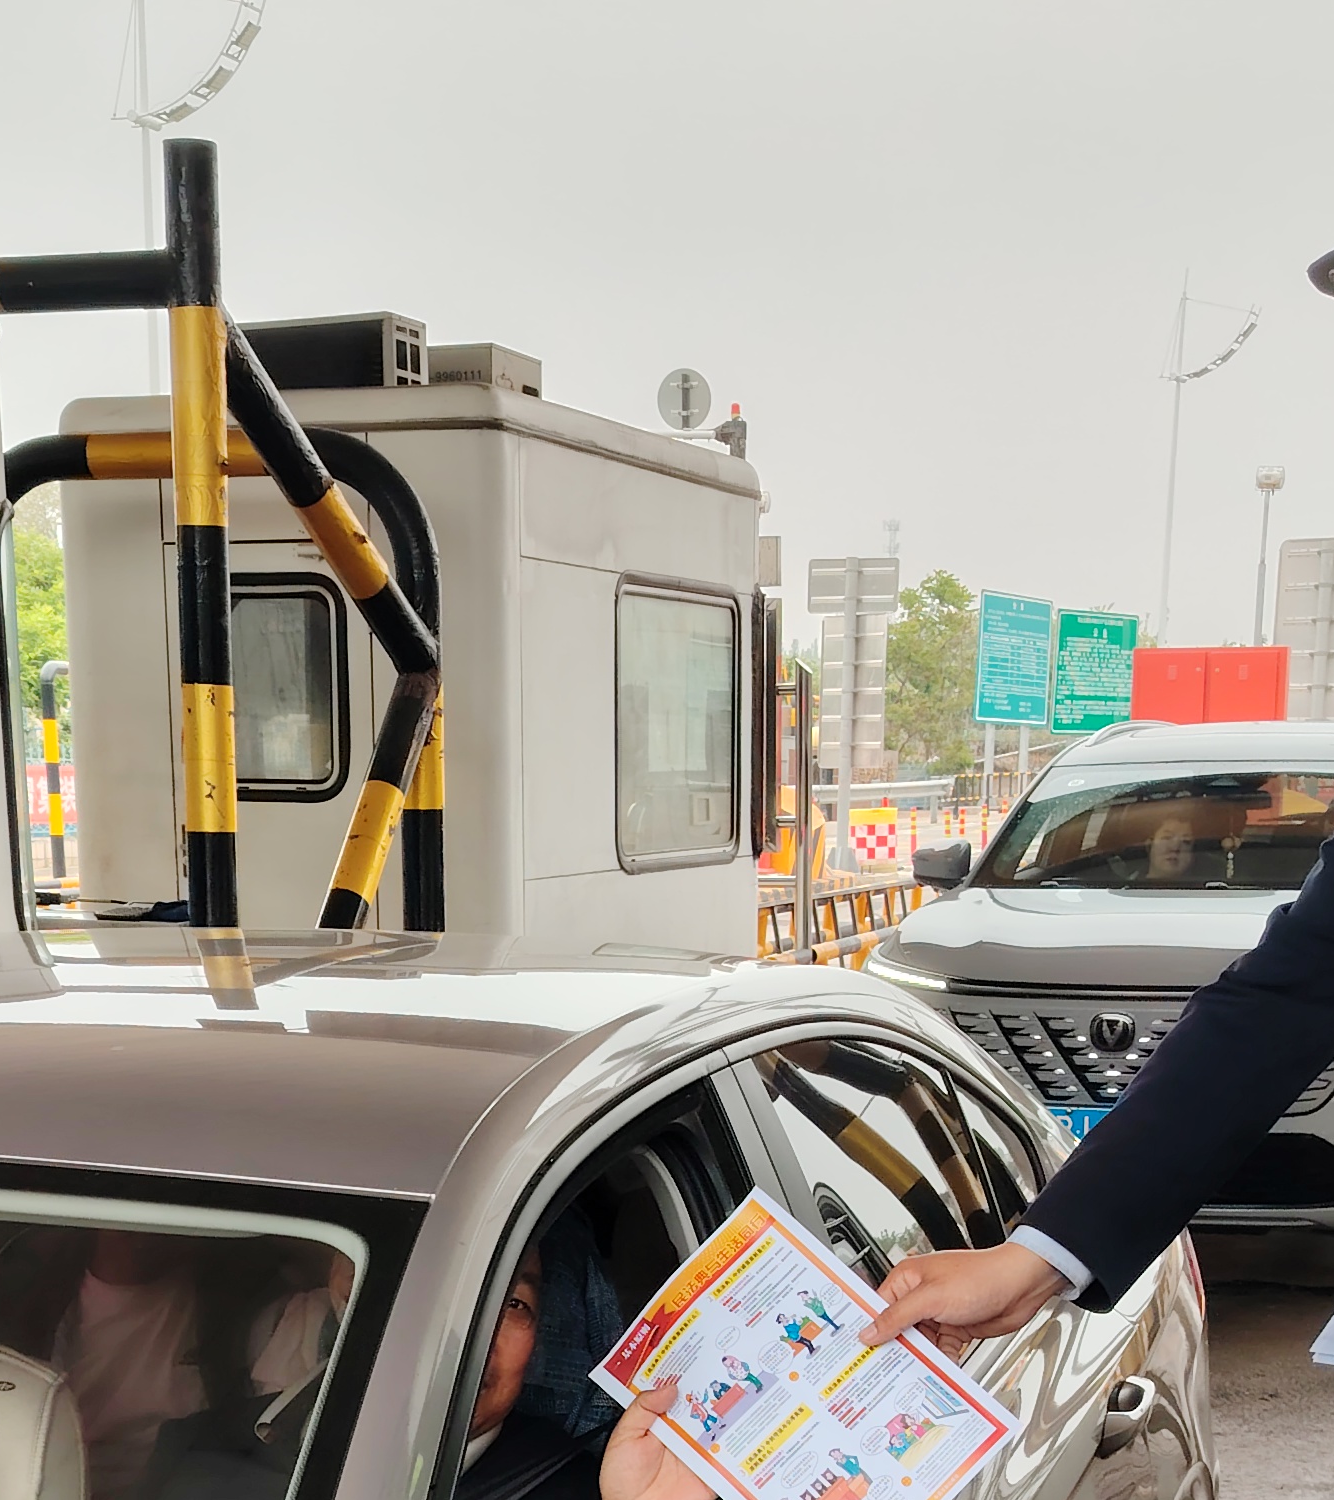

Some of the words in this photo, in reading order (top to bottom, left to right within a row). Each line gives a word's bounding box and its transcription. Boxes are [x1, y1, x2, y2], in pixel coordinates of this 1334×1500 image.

[669, 1210, 768, 1309] 民法典与生活同行
